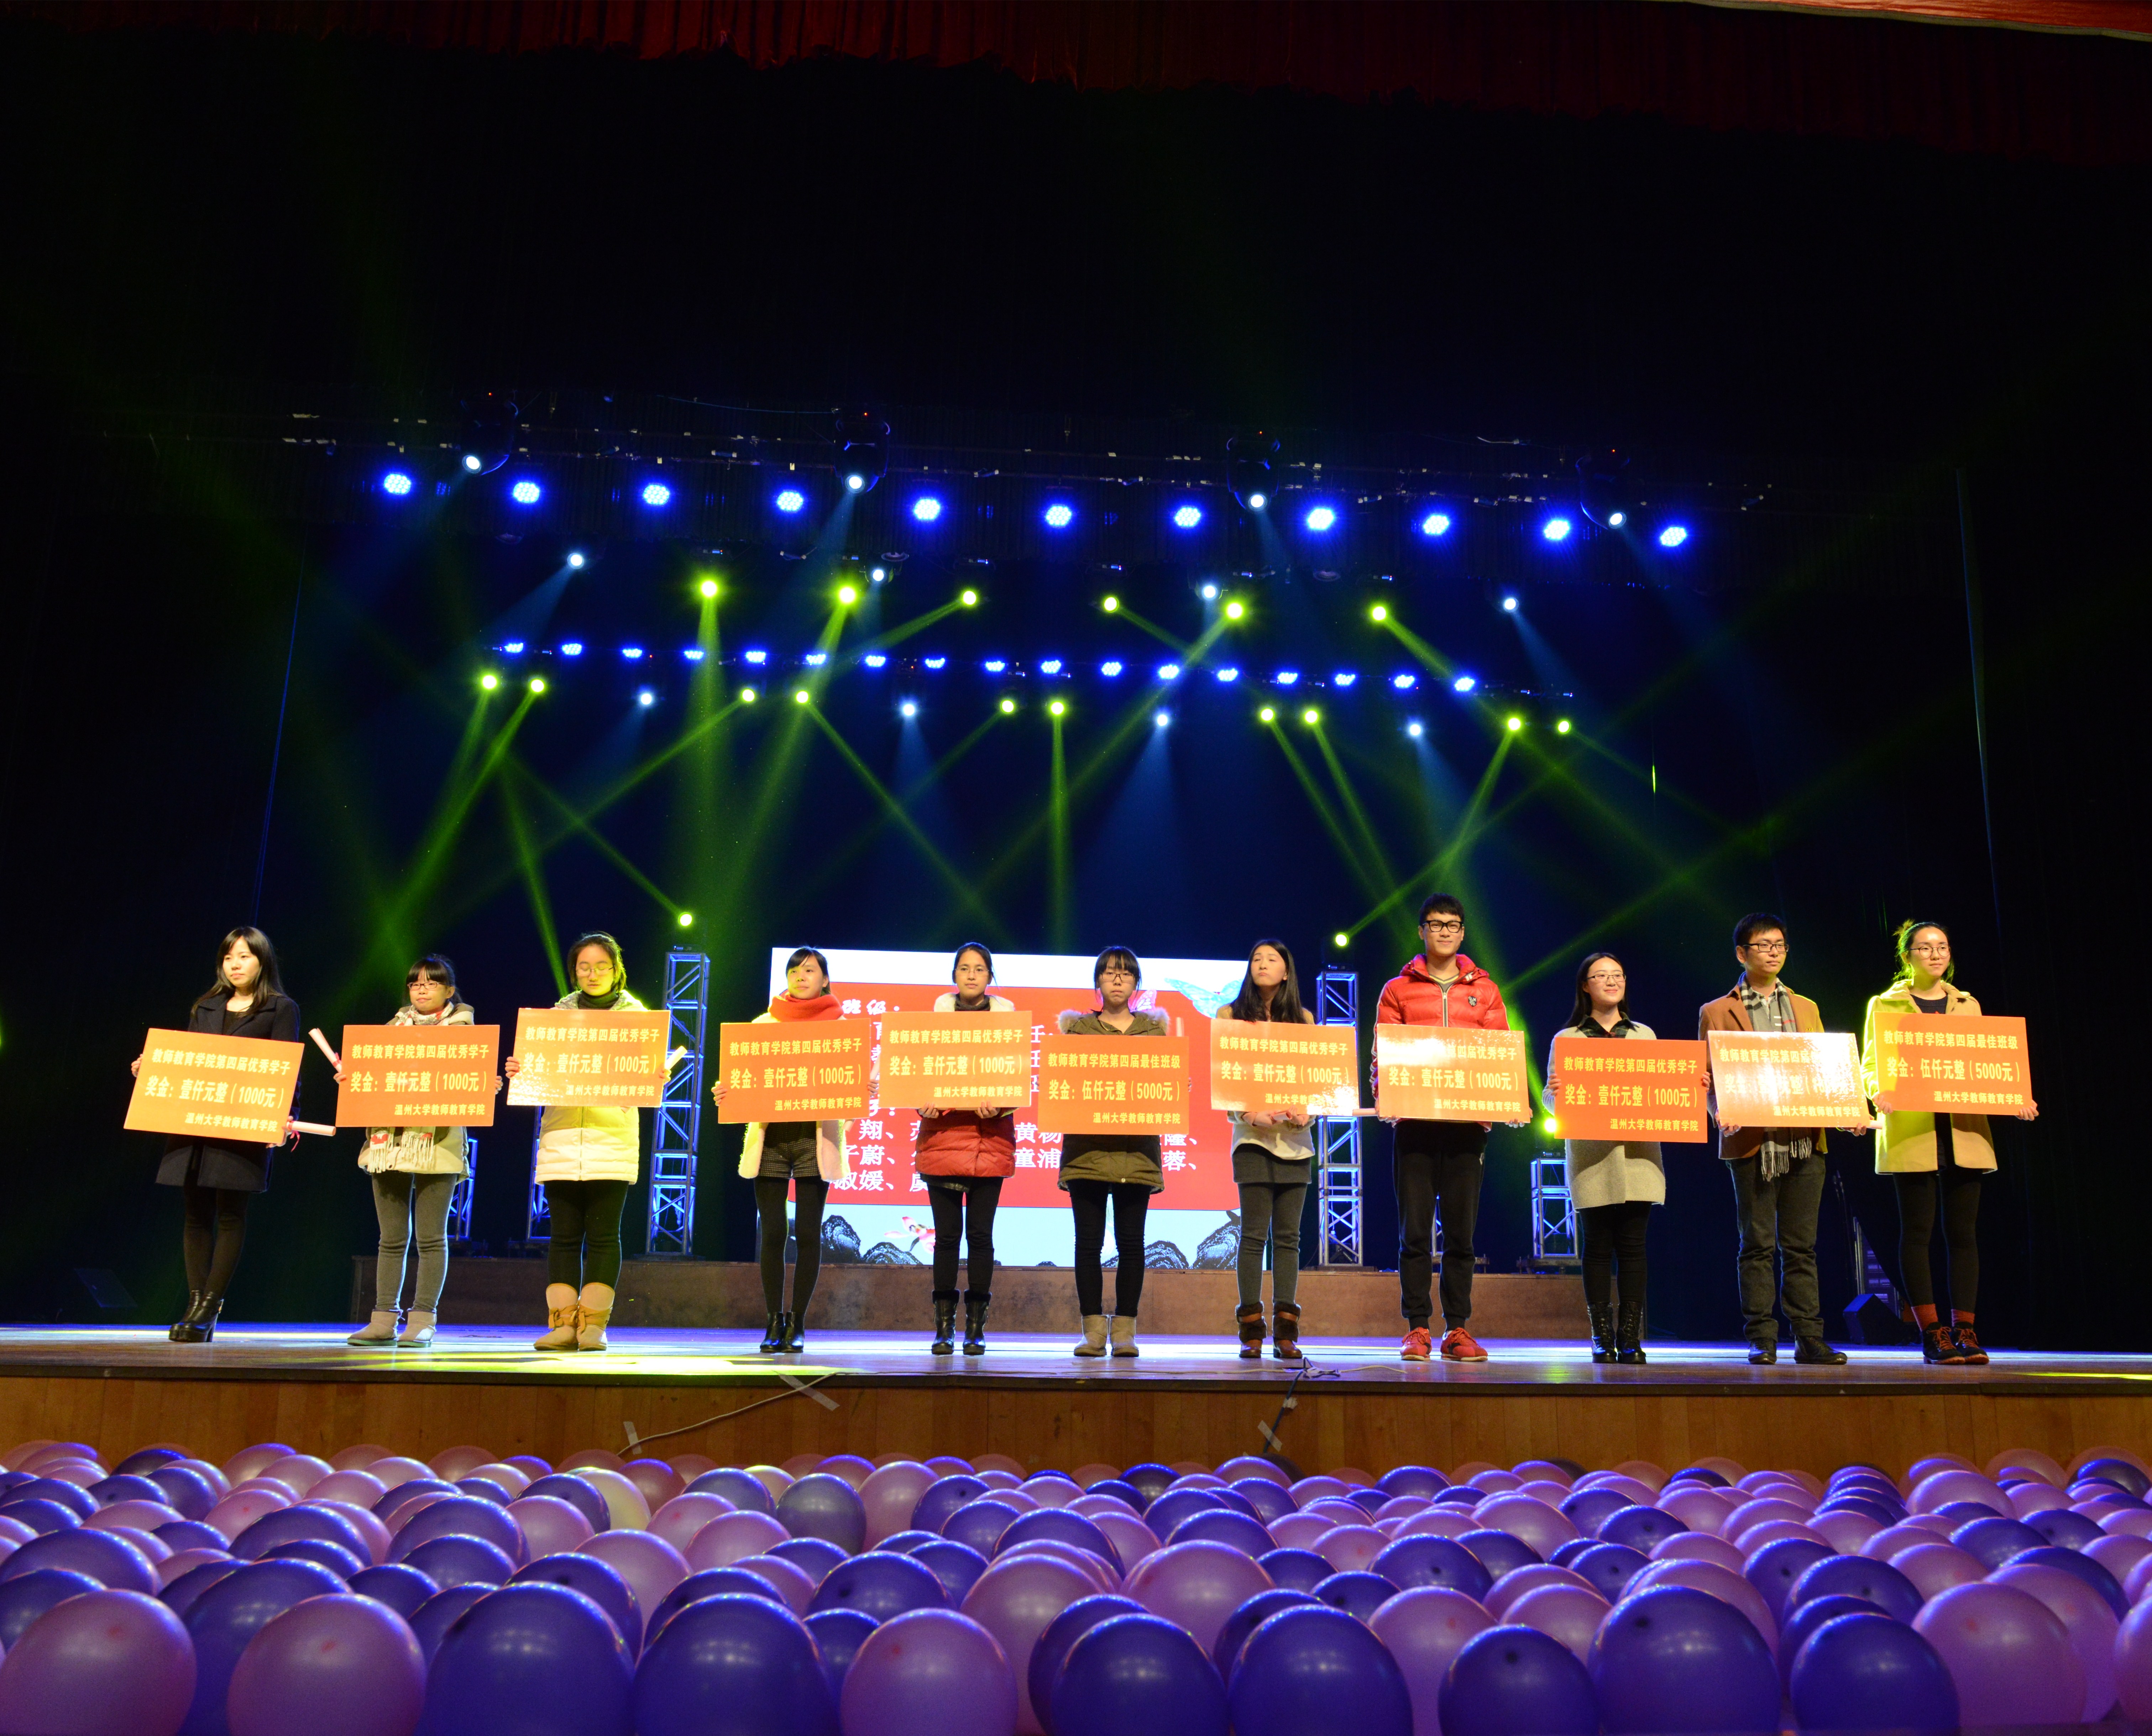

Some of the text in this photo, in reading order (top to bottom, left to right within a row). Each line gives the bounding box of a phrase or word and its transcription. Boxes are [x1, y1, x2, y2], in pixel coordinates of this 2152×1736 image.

[525, 1026, 659, 1042] 教师教育学院第四届优秀学子
[889, 1029, 1023, 1044] 教师教育学院第四届优秀学子
[1884, 1030, 2018, 1049] 教师教育学院第四届最佳班级
[352, 1044, 489, 1059] 教师教育学院第四届优秀学子
[729, 1038, 862, 1056] 教师教育学院第四届优秀学子
[1220, 1036, 1348, 1056] 教师教育学院第四届优秀学子
[152, 1049, 290, 1075] 教师教育学院第四届优秀学子
[1048, 1053, 1180, 1068] 教师教育学院第四届最佳班级
[1564, 1056, 1697, 1074] 教师教育学院第四届优秀学子
[566, 1085, 655, 1096] 温州大学教师教育学院
[934, 1086, 1022, 1097] 温州大学教师教育学院
[1934, 1091, 2023, 1105] 温州大学教师教育学院
[394, 1104, 485, 1115] 温州大学教师教育学院
[775, 1097, 862, 1110] 温州大学教师教育学院
[1434, 1099, 1521, 1112] 温州大学教师教育学院
[1093, 1112, 1180, 1124] 温州大学教师教育学院
[1774, 1106, 1860, 1117] 温州大学教师教育学院
[185, 1112, 278, 1132] 温州大学教师教育学院
[1610, 1118, 1698, 1131] 温州大学教师教育学院
